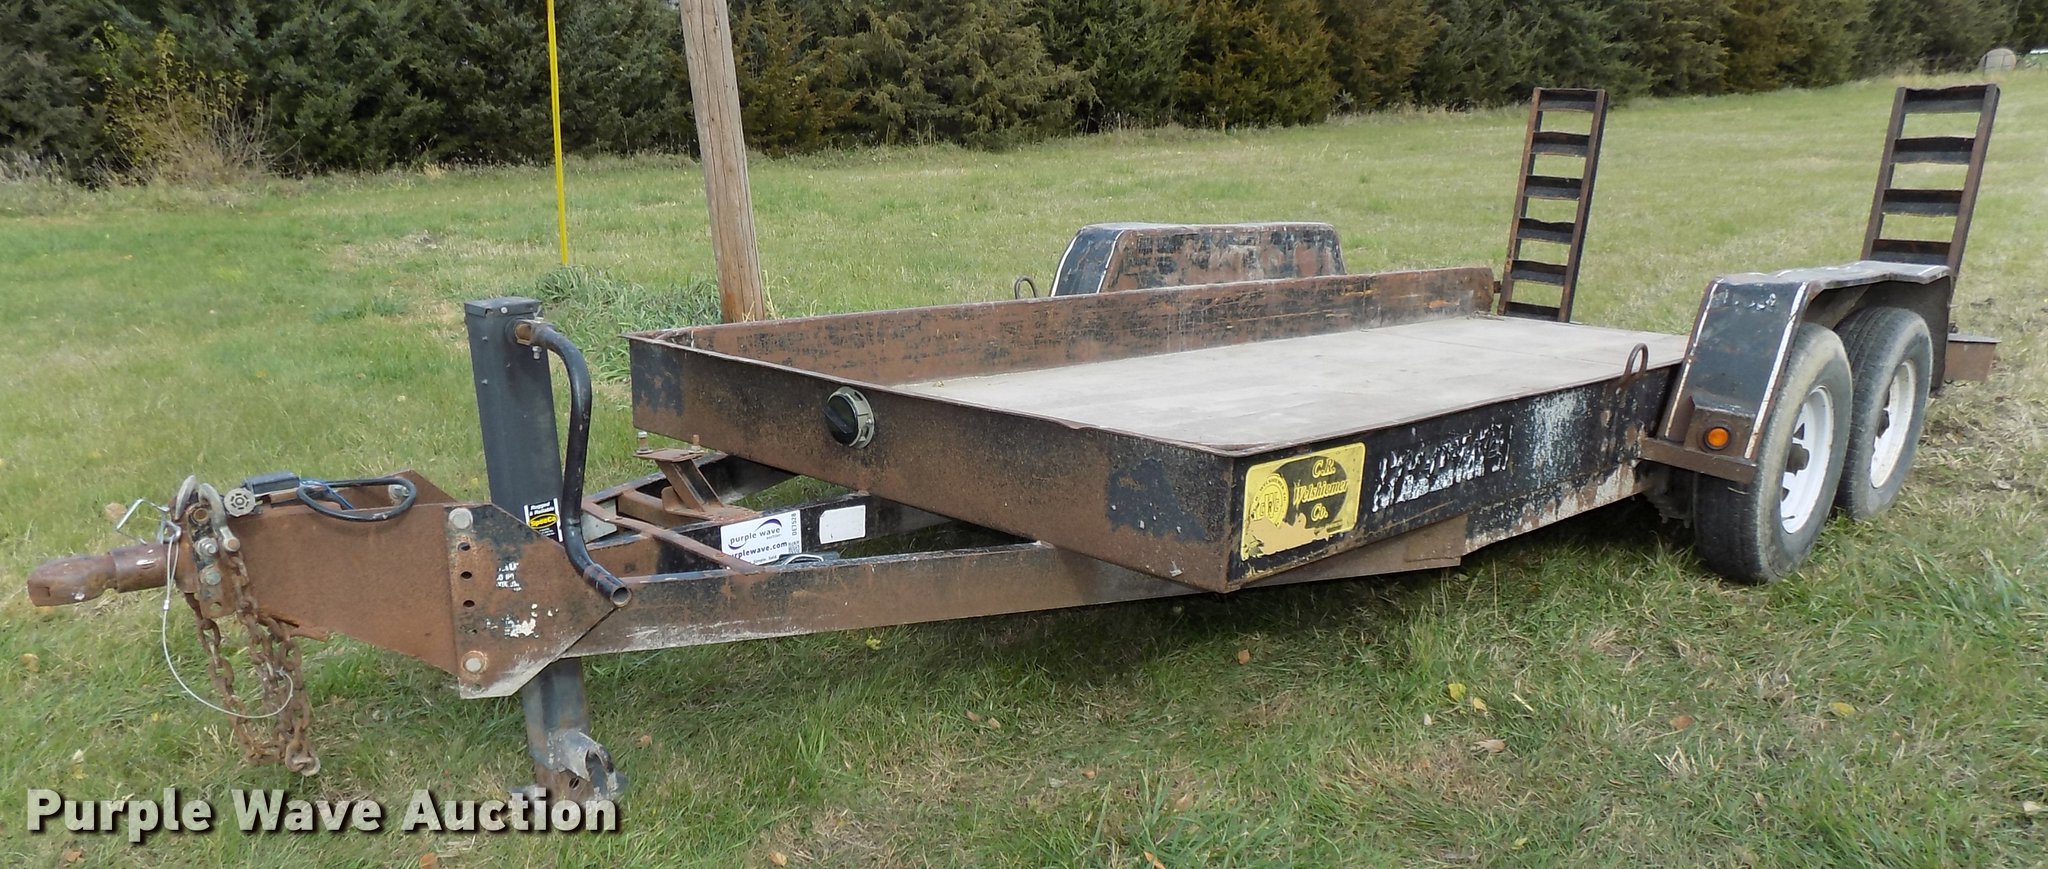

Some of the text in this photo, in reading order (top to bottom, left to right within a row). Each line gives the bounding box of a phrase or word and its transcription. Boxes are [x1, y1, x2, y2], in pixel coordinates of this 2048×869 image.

[1311, 502, 1328, 522] Co.
[729, 527, 781, 545] purple wave
